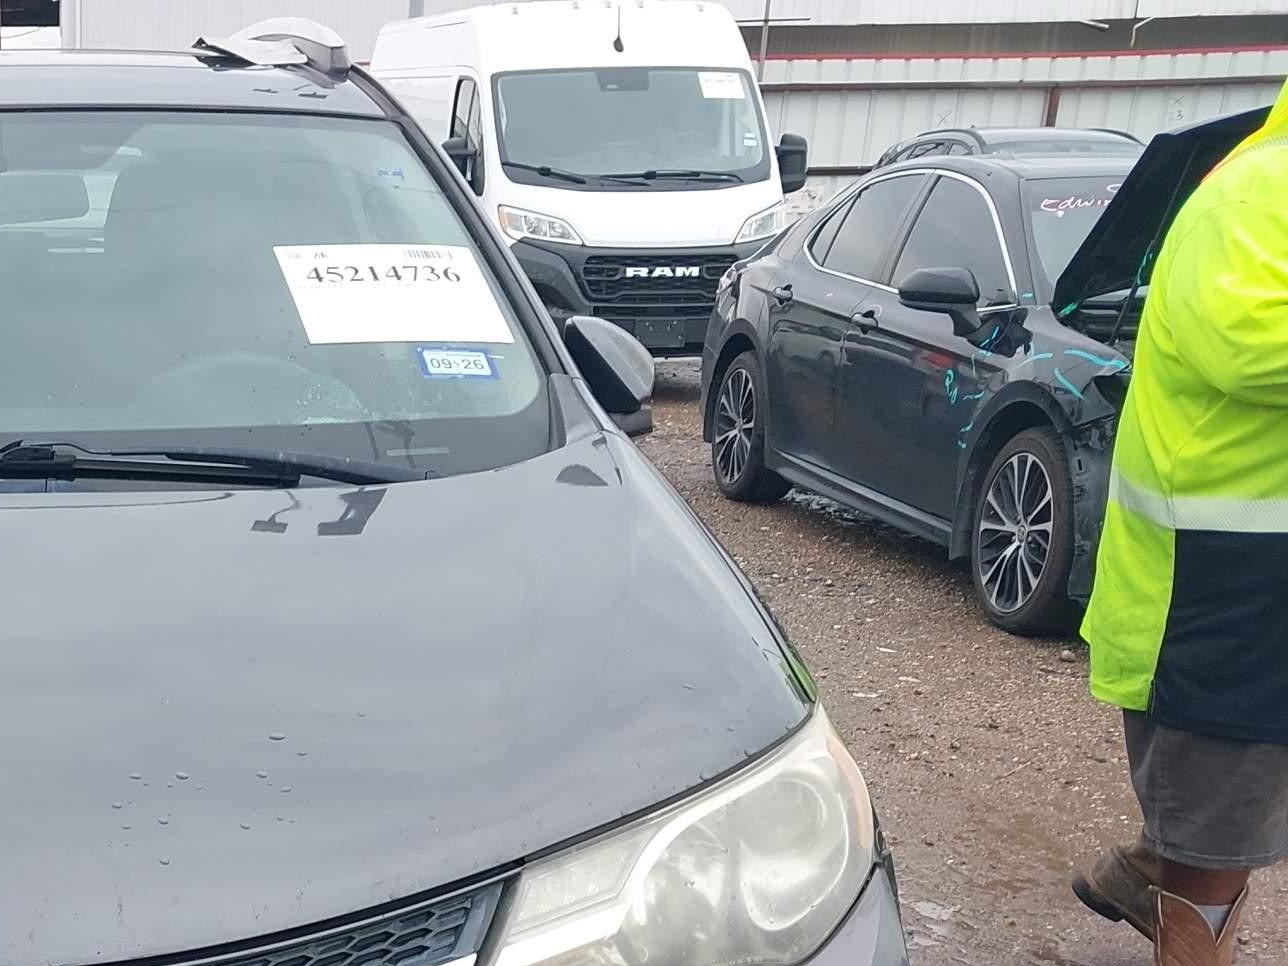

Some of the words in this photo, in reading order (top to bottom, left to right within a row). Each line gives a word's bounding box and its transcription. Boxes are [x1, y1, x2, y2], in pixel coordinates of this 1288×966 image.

[306, 265, 462, 283] 45214736
[625, 266, 700, 278] RAM
[430, 358, 452, 369] 09
[461, 359, 485, 370] 26
